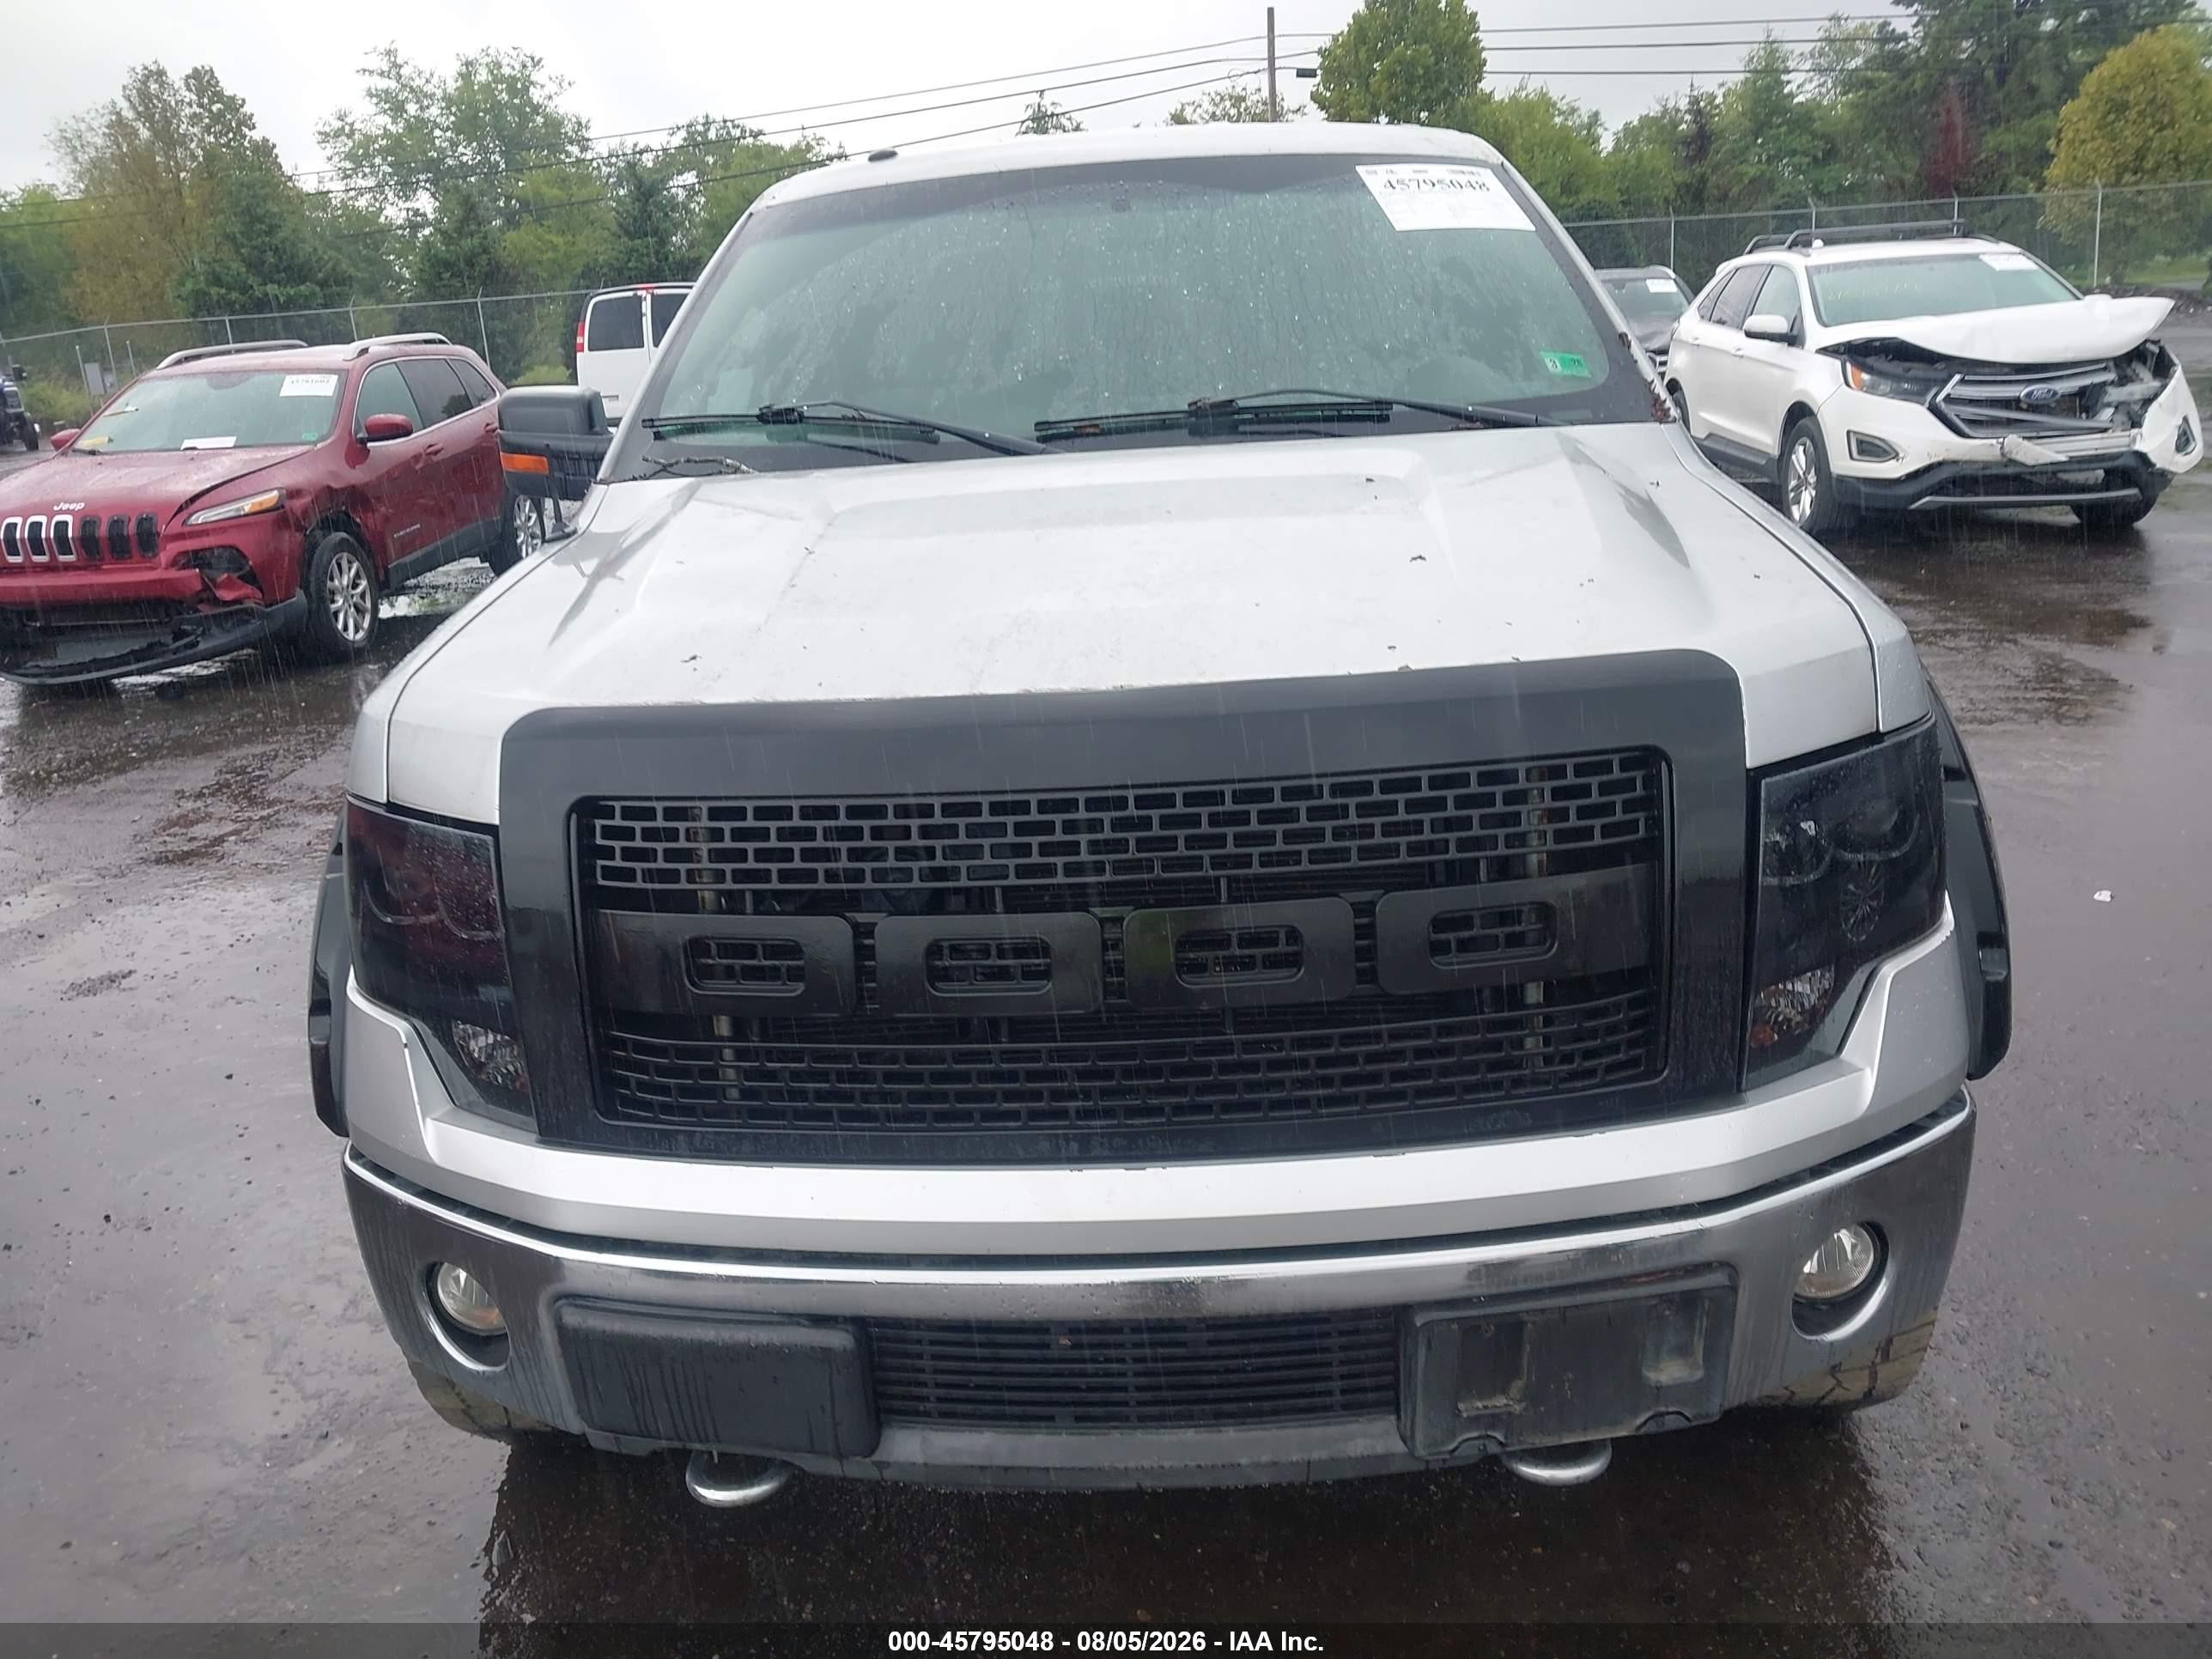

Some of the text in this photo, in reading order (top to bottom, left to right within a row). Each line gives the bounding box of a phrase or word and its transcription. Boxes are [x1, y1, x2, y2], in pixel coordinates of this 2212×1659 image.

[1383, 177, 1490, 192] 45795048
[2030, 388, 2054, 399] Ford
[52, 501, 85, 512] Jeep
